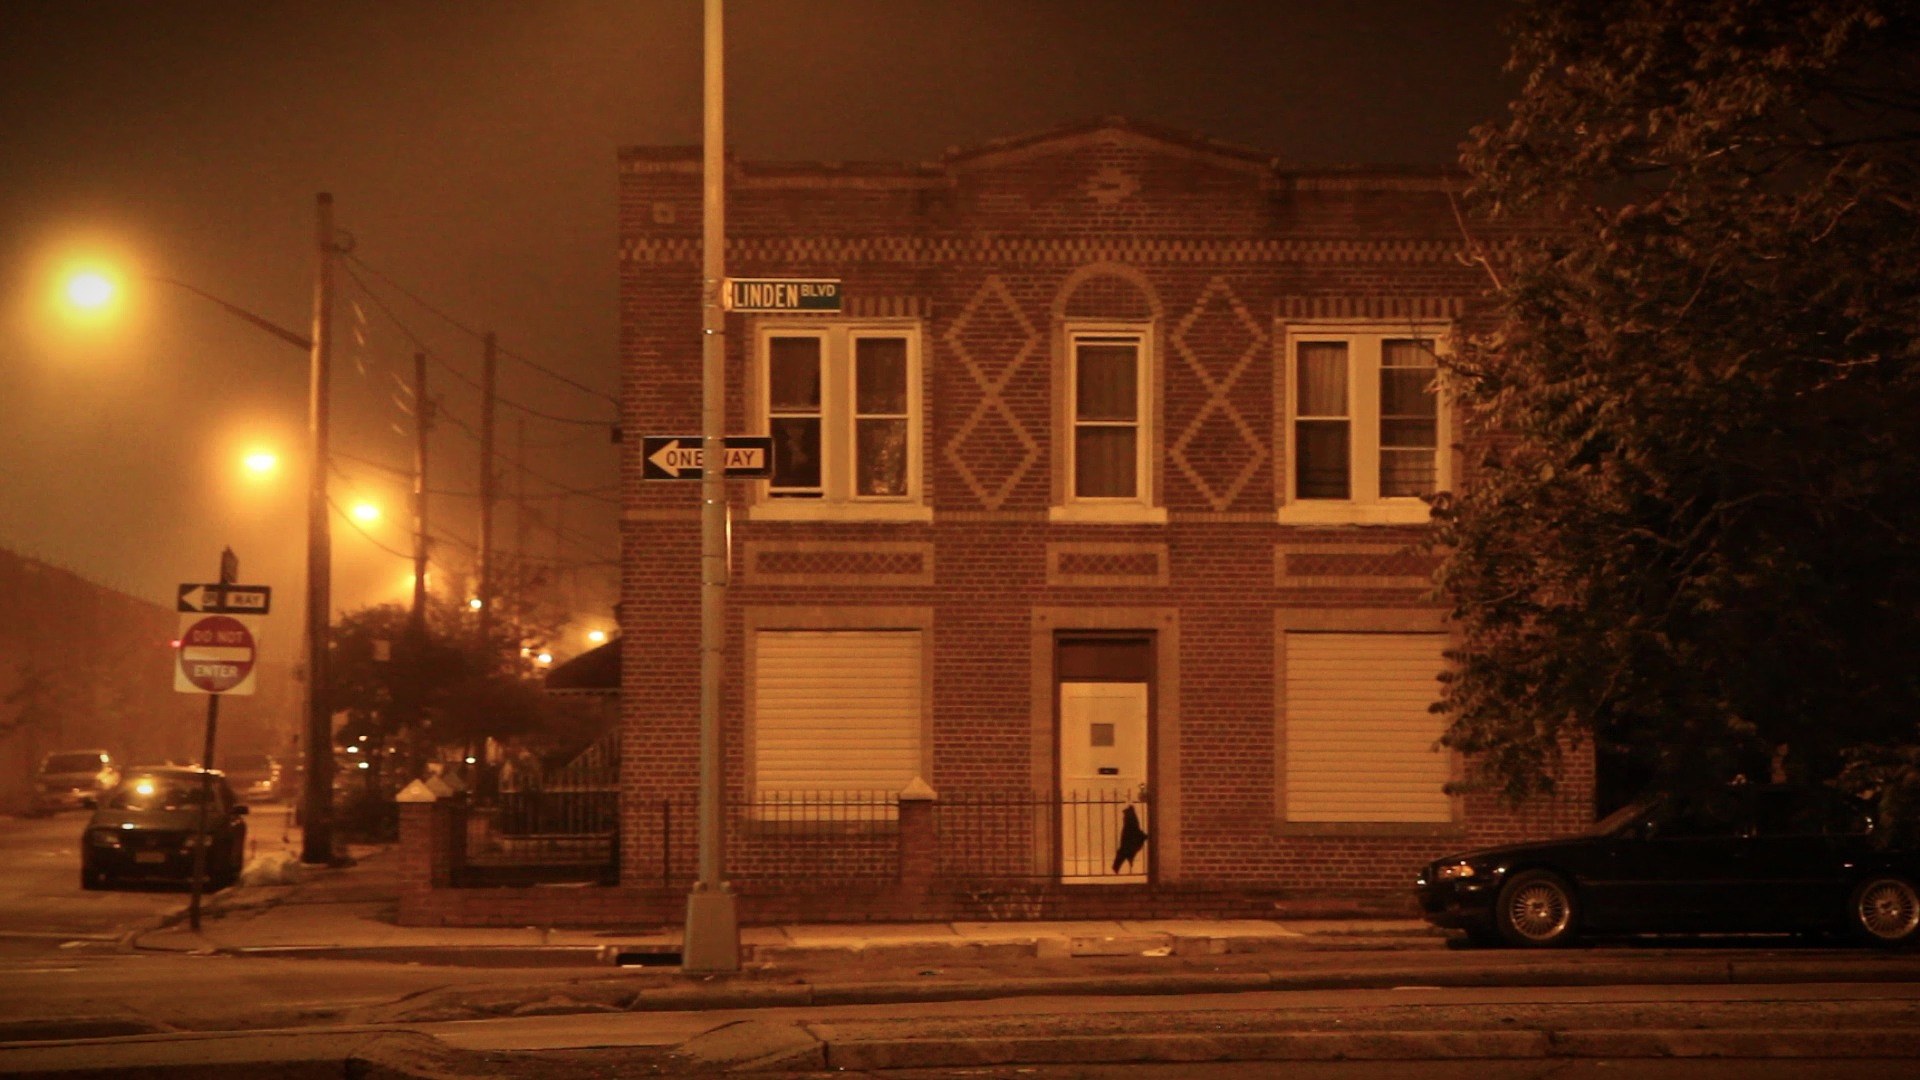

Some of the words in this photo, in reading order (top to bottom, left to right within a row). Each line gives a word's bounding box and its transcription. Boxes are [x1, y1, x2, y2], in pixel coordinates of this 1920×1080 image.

[734, 283, 798, 307] LINDEN
[801, 284, 836, 297] BLVD
[666, 450, 703, 466] ONE
[193, 629, 212, 643] DO
[217, 631, 243, 643] NOT
[193, 664, 238, 677] ENTER
